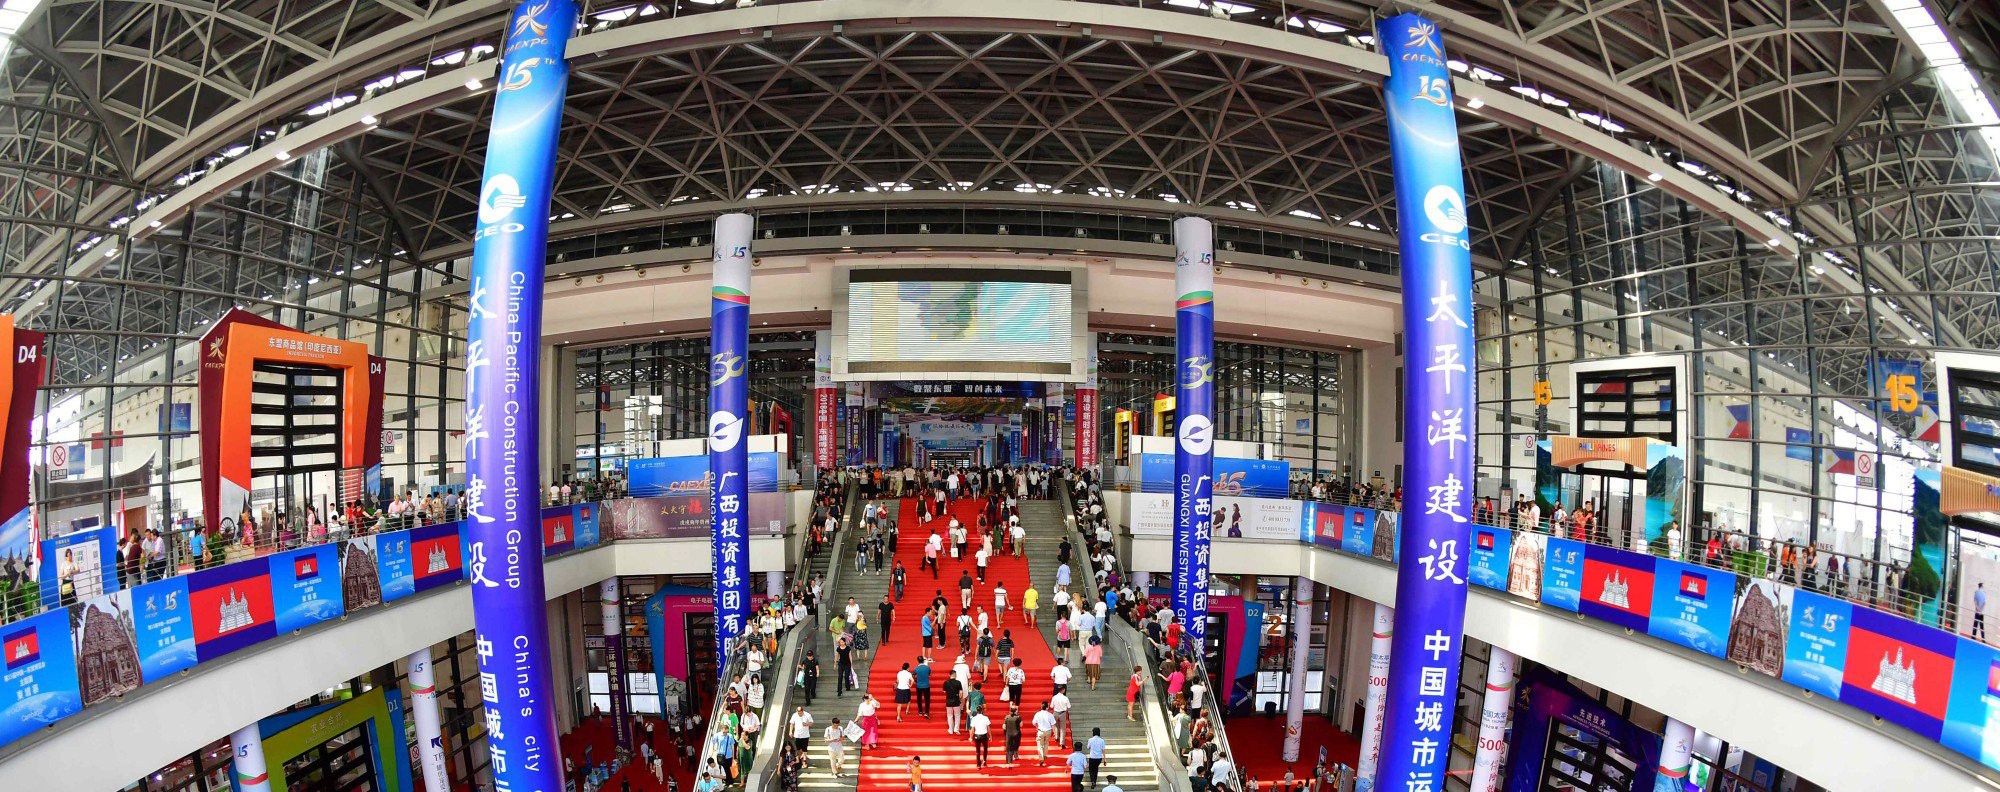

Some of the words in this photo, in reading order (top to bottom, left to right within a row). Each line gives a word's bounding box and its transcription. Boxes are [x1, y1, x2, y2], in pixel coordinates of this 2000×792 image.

[499, 57, 541, 93] 15
[1411, 75, 1449, 107] 15
[474, 222, 525, 242] CEO
[1420, 233, 1471, 250] CEO
[732, 246, 747, 260] 15
[1199, 252, 1212, 265] 15
[507, 271, 526, 325] China
[18, 345, 37, 364] D4
[370, 362, 381, 374] D4
[504, 331, 522, 395] Pacific
[1885, 374, 1918, 413] 15
[465, 276, 500, 589] 太平洋建设
[1418, 279, 1468, 585] 太平洋建设
[502, 400, 519, 523] Construction
[709, 471, 717, 524] GUANGXI
[1180, 473, 1190, 527] GUANGXI
[505, 529, 522, 589] Group
[710, 528, 718, 602] INVESTMENT
[1178, 535, 1190, 605] INVESTMENT
[165, 591, 178, 611] 15
[1247, 608, 1259, 617] D2
[629, 615, 645, 636] 2
[1267, 615, 1282, 635] 2
[1824, 613, 1837, 633] 15
[388, 702, 399, 713] D1
[513, 635, 534, 717] China's
[524, 735, 541, 773] city
[237, 744, 248, 757] 15
